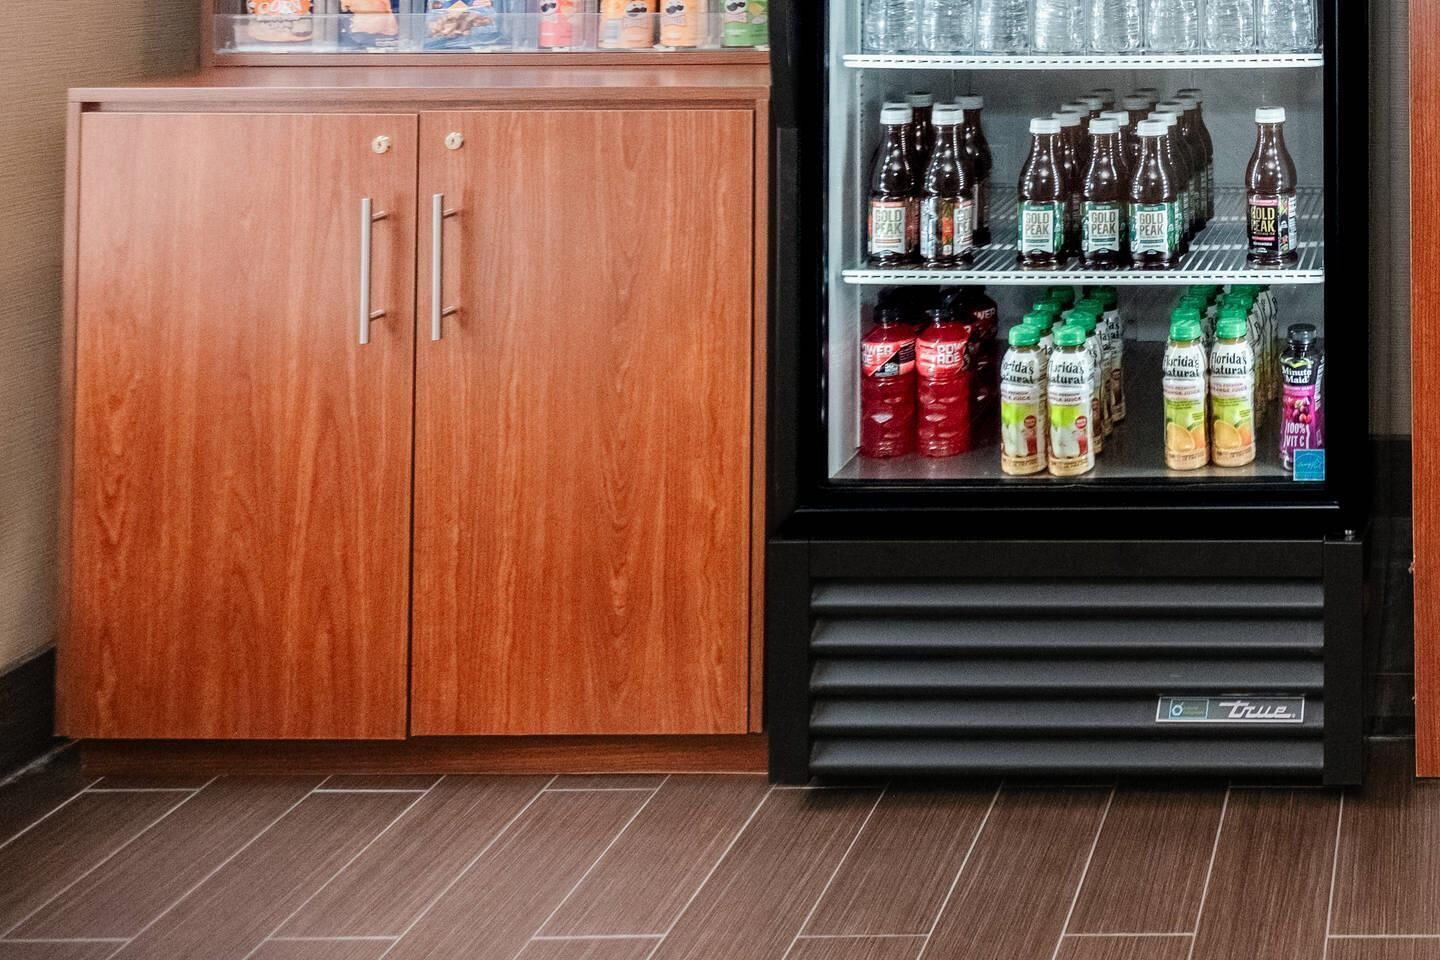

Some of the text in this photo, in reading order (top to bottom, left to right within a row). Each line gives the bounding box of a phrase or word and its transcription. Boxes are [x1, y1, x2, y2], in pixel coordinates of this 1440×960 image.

[874, 210, 902, 222] GOLD
[1025, 212, 1050, 223] GOLD
[1091, 212, 1116, 222] GOLD
[1139, 213, 1164, 223] GOLD
[1250, 206, 1275, 220] GOLD
[874, 223, 902, 234] PEAK
[1025, 224, 1050, 235] PEAK
[1091, 224, 1116, 234] PEAK
[1139, 225, 1164, 235] PEAK
[1250, 220, 1275, 232] PEAK
[1282, 367, 1312, 377] Minute
[1285, 375, 1309, 383] Maid
[1287, 422, 1306, 434] 100%
[1286, 435, 1305, 447] VIT C
